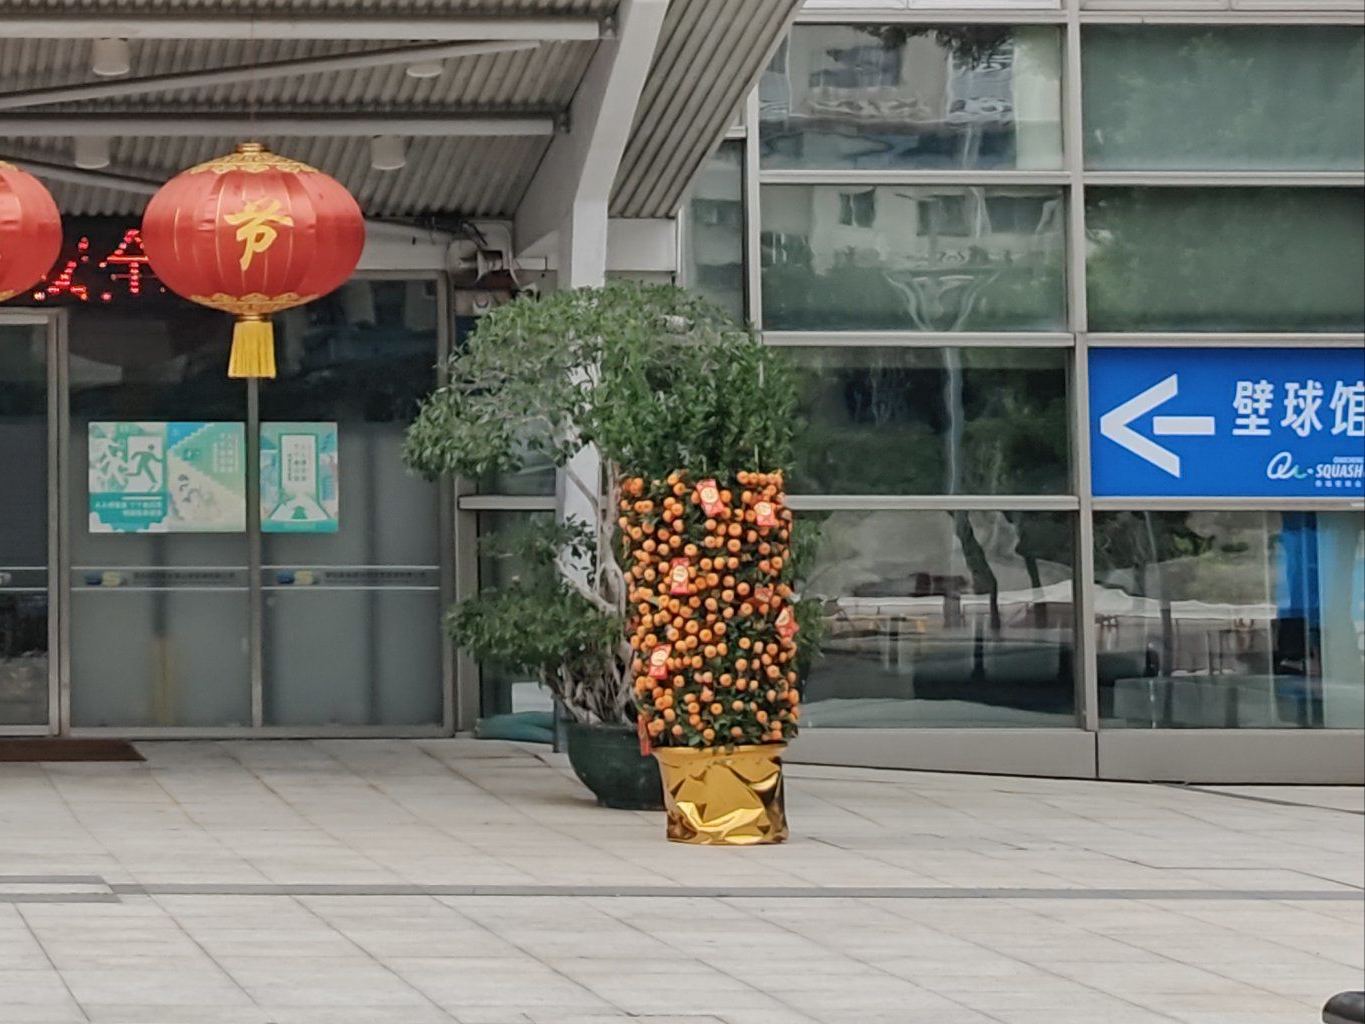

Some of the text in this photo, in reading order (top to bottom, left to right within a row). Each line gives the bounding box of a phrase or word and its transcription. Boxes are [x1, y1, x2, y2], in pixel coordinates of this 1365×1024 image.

[222, 196, 295, 272] 节
[1232, 379, 1365, 437] 壁球馆
[1315, 463, 1364, 479] SQUASH
